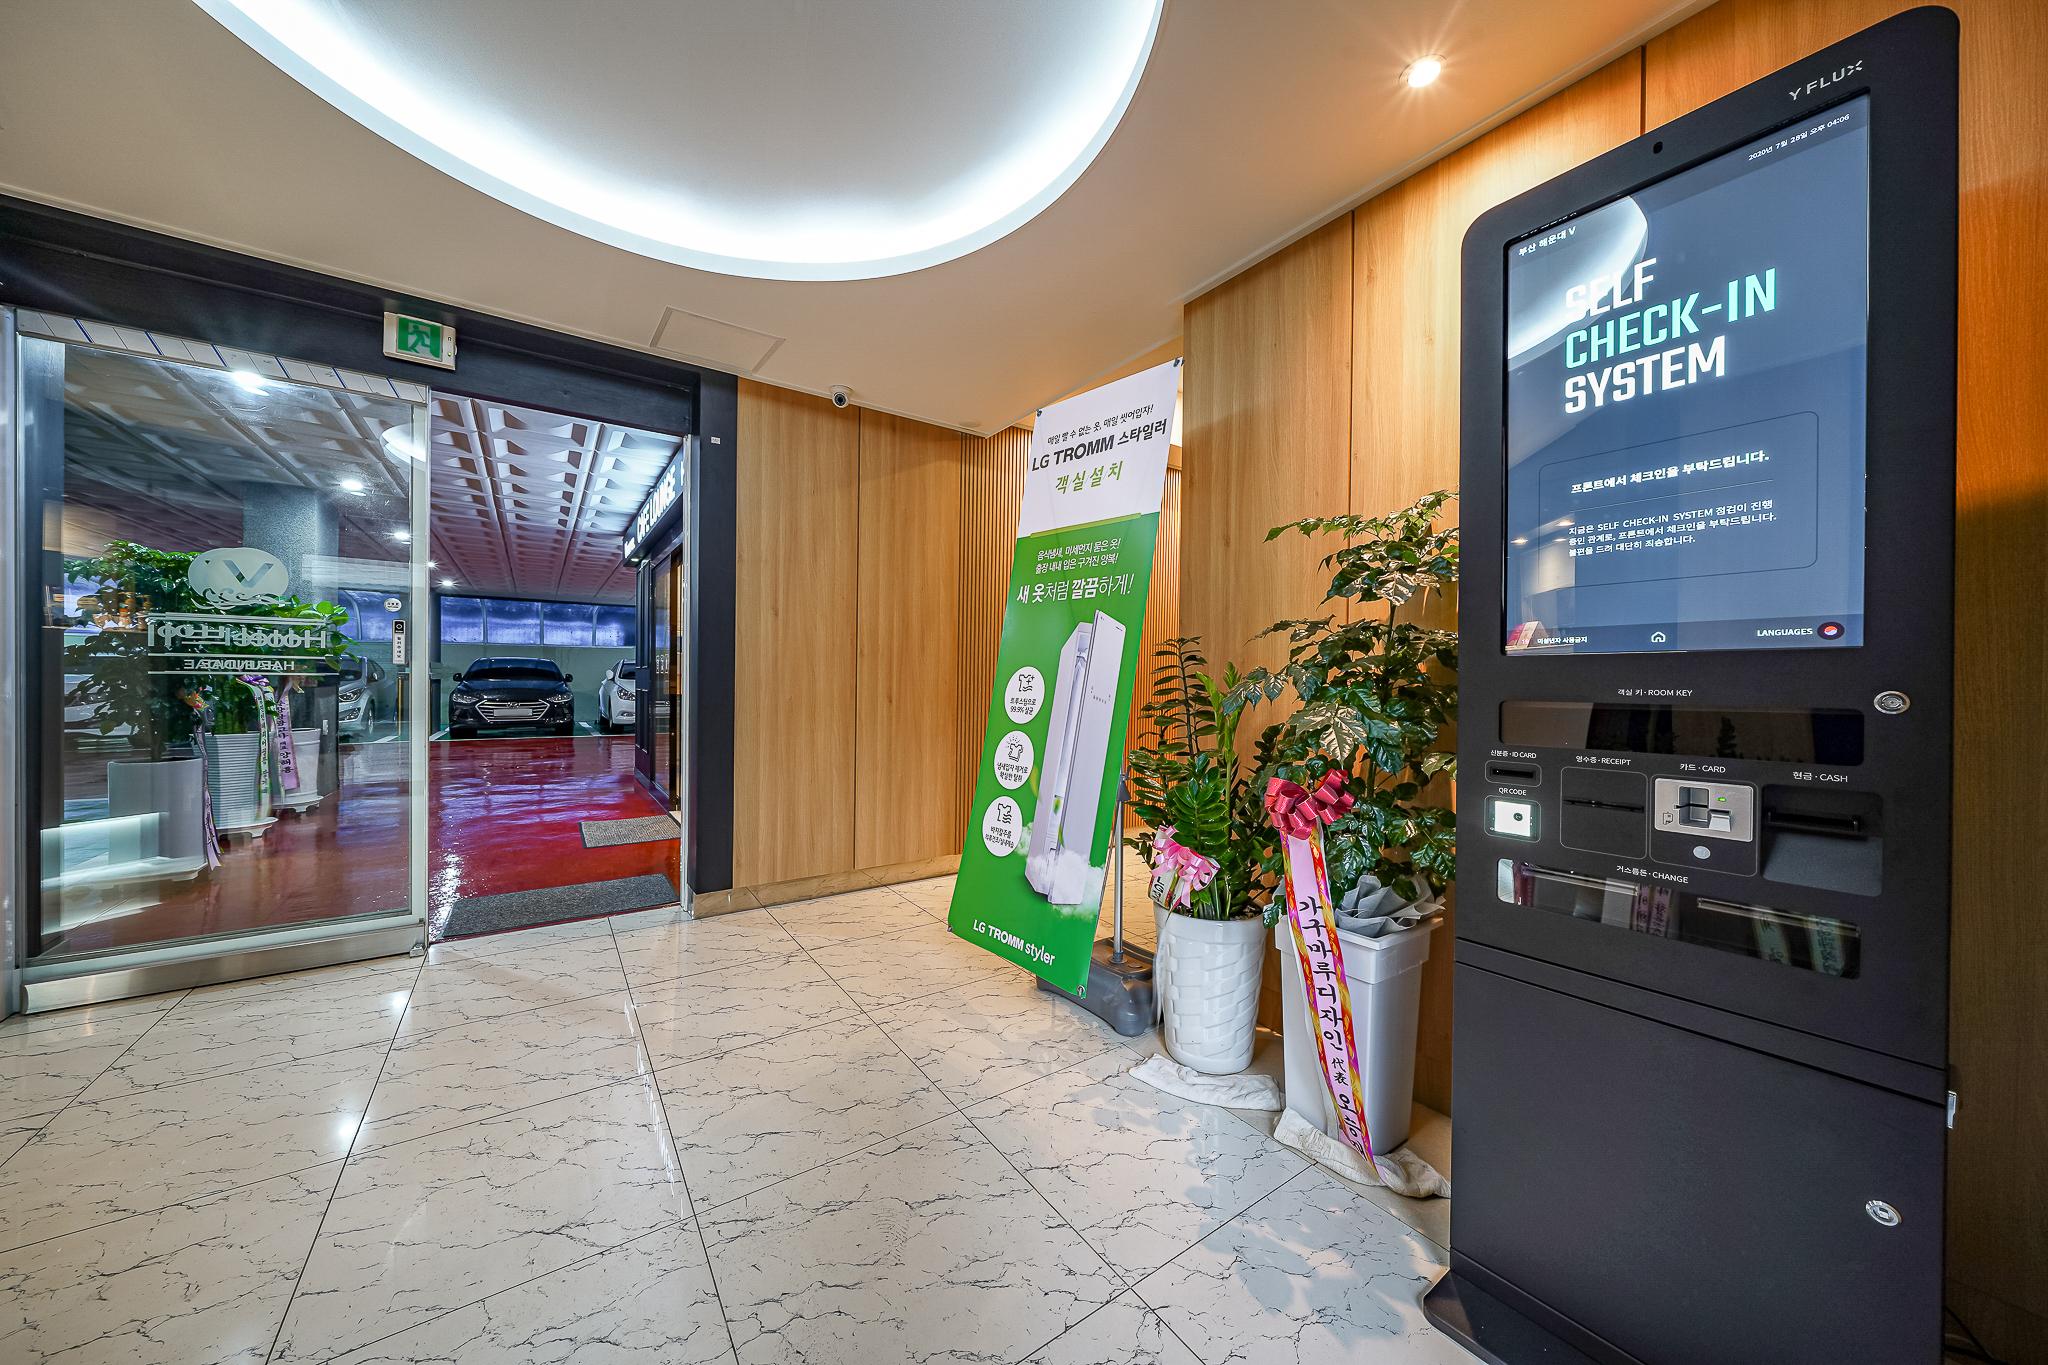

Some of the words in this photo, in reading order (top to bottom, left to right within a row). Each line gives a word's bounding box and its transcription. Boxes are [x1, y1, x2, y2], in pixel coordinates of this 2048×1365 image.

[1788, 87, 1801, 101] Y
[1806, 60, 1863, 95] FLUX
[1827, 113, 1850, 128] 04:06
[1518, 242, 1537, 256] 부산
[1539, 229, 1567, 247] 해운대
[1568, 226, 1576, 235] V
[1565, 257, 1657, 321] SELF
[1565, 267, 1777, 369] CHECK-IN
[1565, 335, 1726, 414] SYSTEM
[1031, 454, 1050, 472] LG
[1053, 435, 1115, 466] TROMM
[1117, 418, 1167, 445] 스타일러
[1571, 475, 1627, 494] 프론트에서
[1630, 466, 1680, 483] 체크인을
[1682, 449, 1770, 475] 부탁드립니다.
[1568, 524, 1594, 535] 지금은
[1597, 521, 1619, 531] SELF
[1623, 514, 1669, 528] CHECK-IN
[1673, 508, 1713, 521] SYSTEM
[1715, 503, 1747, 516] 점검이
[1751, 499, 1773, 511] 진행
[1618, 526, 1664, 540] 프론트에서
[1666, 521, 1706, 533] 체크인을
[1708, 512, 1777, 529] 부탁드립니다.
[1065, 542, 1092, 556] 미세먼지
[1596, 544, 1613, 554] 드려
[1616, 540, 1642, 551] 대단히
[1645, 535, 1696, 547] 죄송합니다.
[1016, 584, 1030, 604] 새
[1032, 580, 1069, 603] 옷처럼
[1071, 573, 1135, 600] 깔끔하게!
[1757, 628, 1813, 637] LANGUAGES
[1675, 689, 1693, 697] KEY
[1519, 751, 1537, 759] CARD
[1601, 757, 1632, 766] RECEIPT
[1680, 763, 1697, 771] 카드
[1701, 765, 1726, 773] CARD
[1792, 771, 1812, 781] 현금
[1820, 773, 1848, 783] CASH
[1498, 787, 1508, 795] QR
[1509, 788, 1527, 796] CODE
[1616, 865, 1647, 877] 거스름돈
[1652, 871, 1690, 884] CHANGE
[973, 919, 986, 934] LG
[988, 924, 1025, 951] TROMM
[1025, 943, 1055, 966] styler
